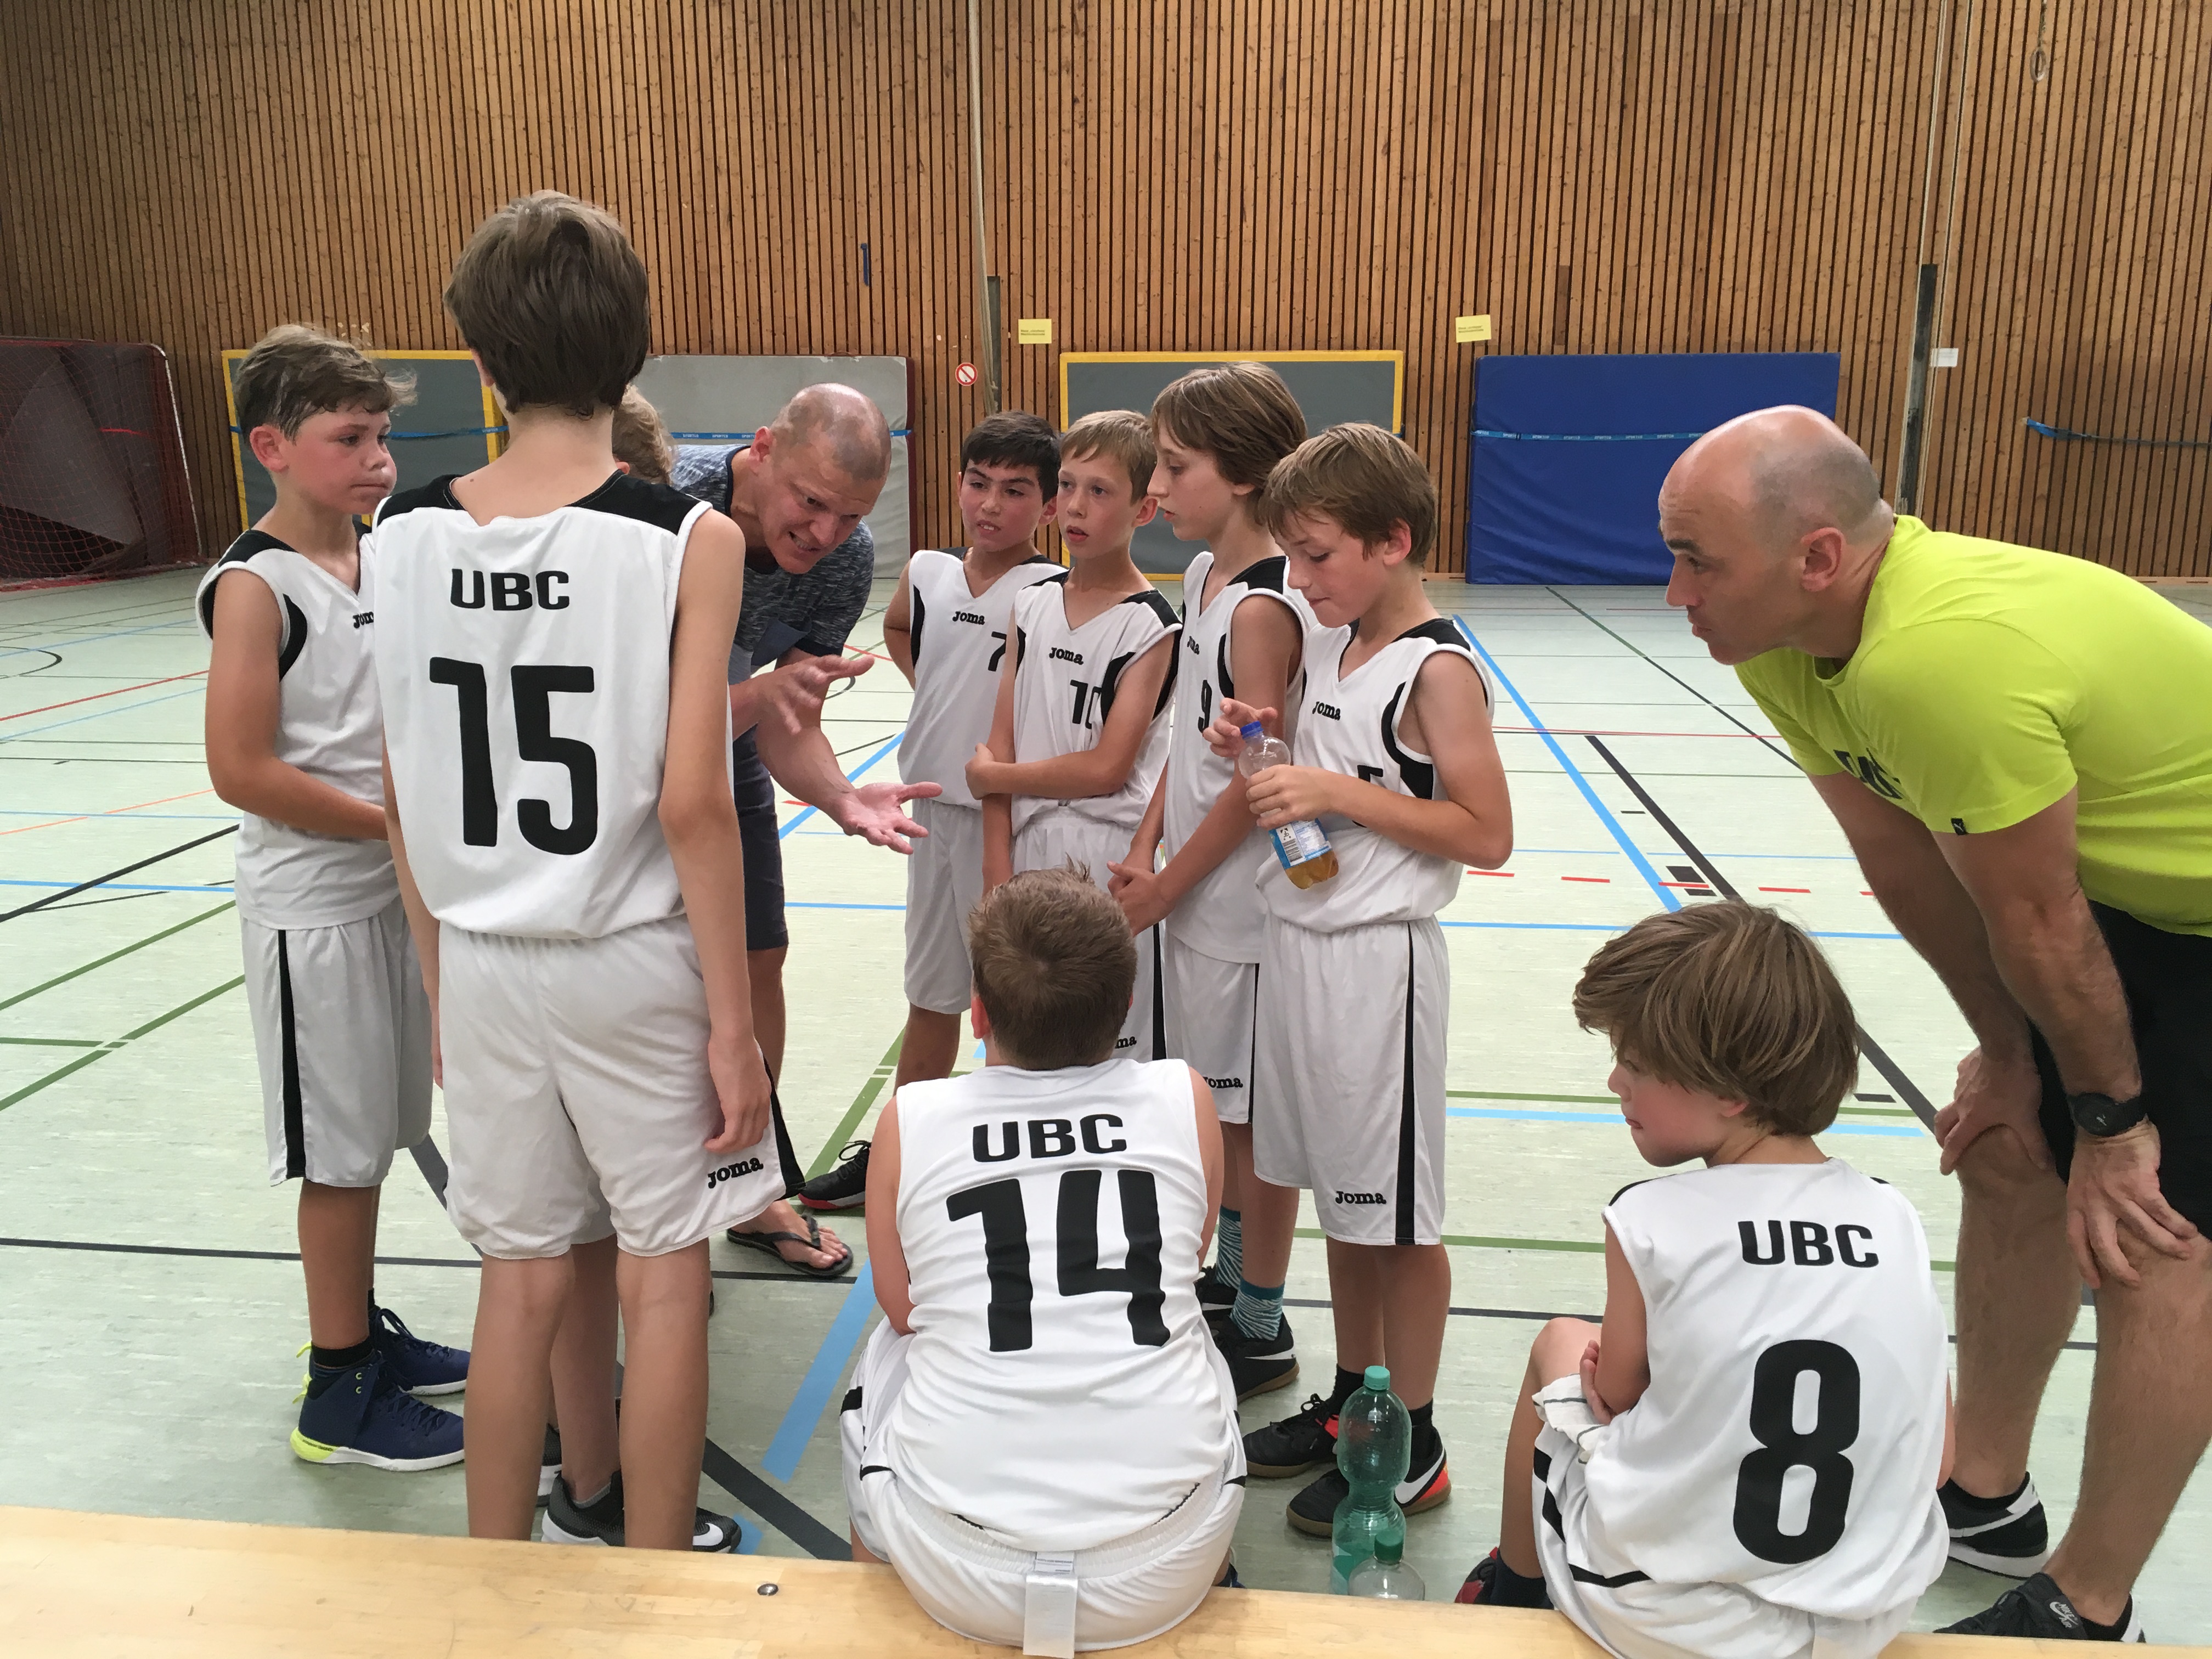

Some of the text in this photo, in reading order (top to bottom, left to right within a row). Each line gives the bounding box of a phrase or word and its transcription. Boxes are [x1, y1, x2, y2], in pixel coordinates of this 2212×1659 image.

[450, 568, 569, 611] UBC
[988, 631, 1007, 672] 7
[430, 657, 598, 855] 15
[973, 1114, 1127, 1163] UBC
[946, 1169, 1171, 1352] 14
[1738, 1220, 1879, 1268] UBC
[1733, 1339, 1860, 1565] 8
